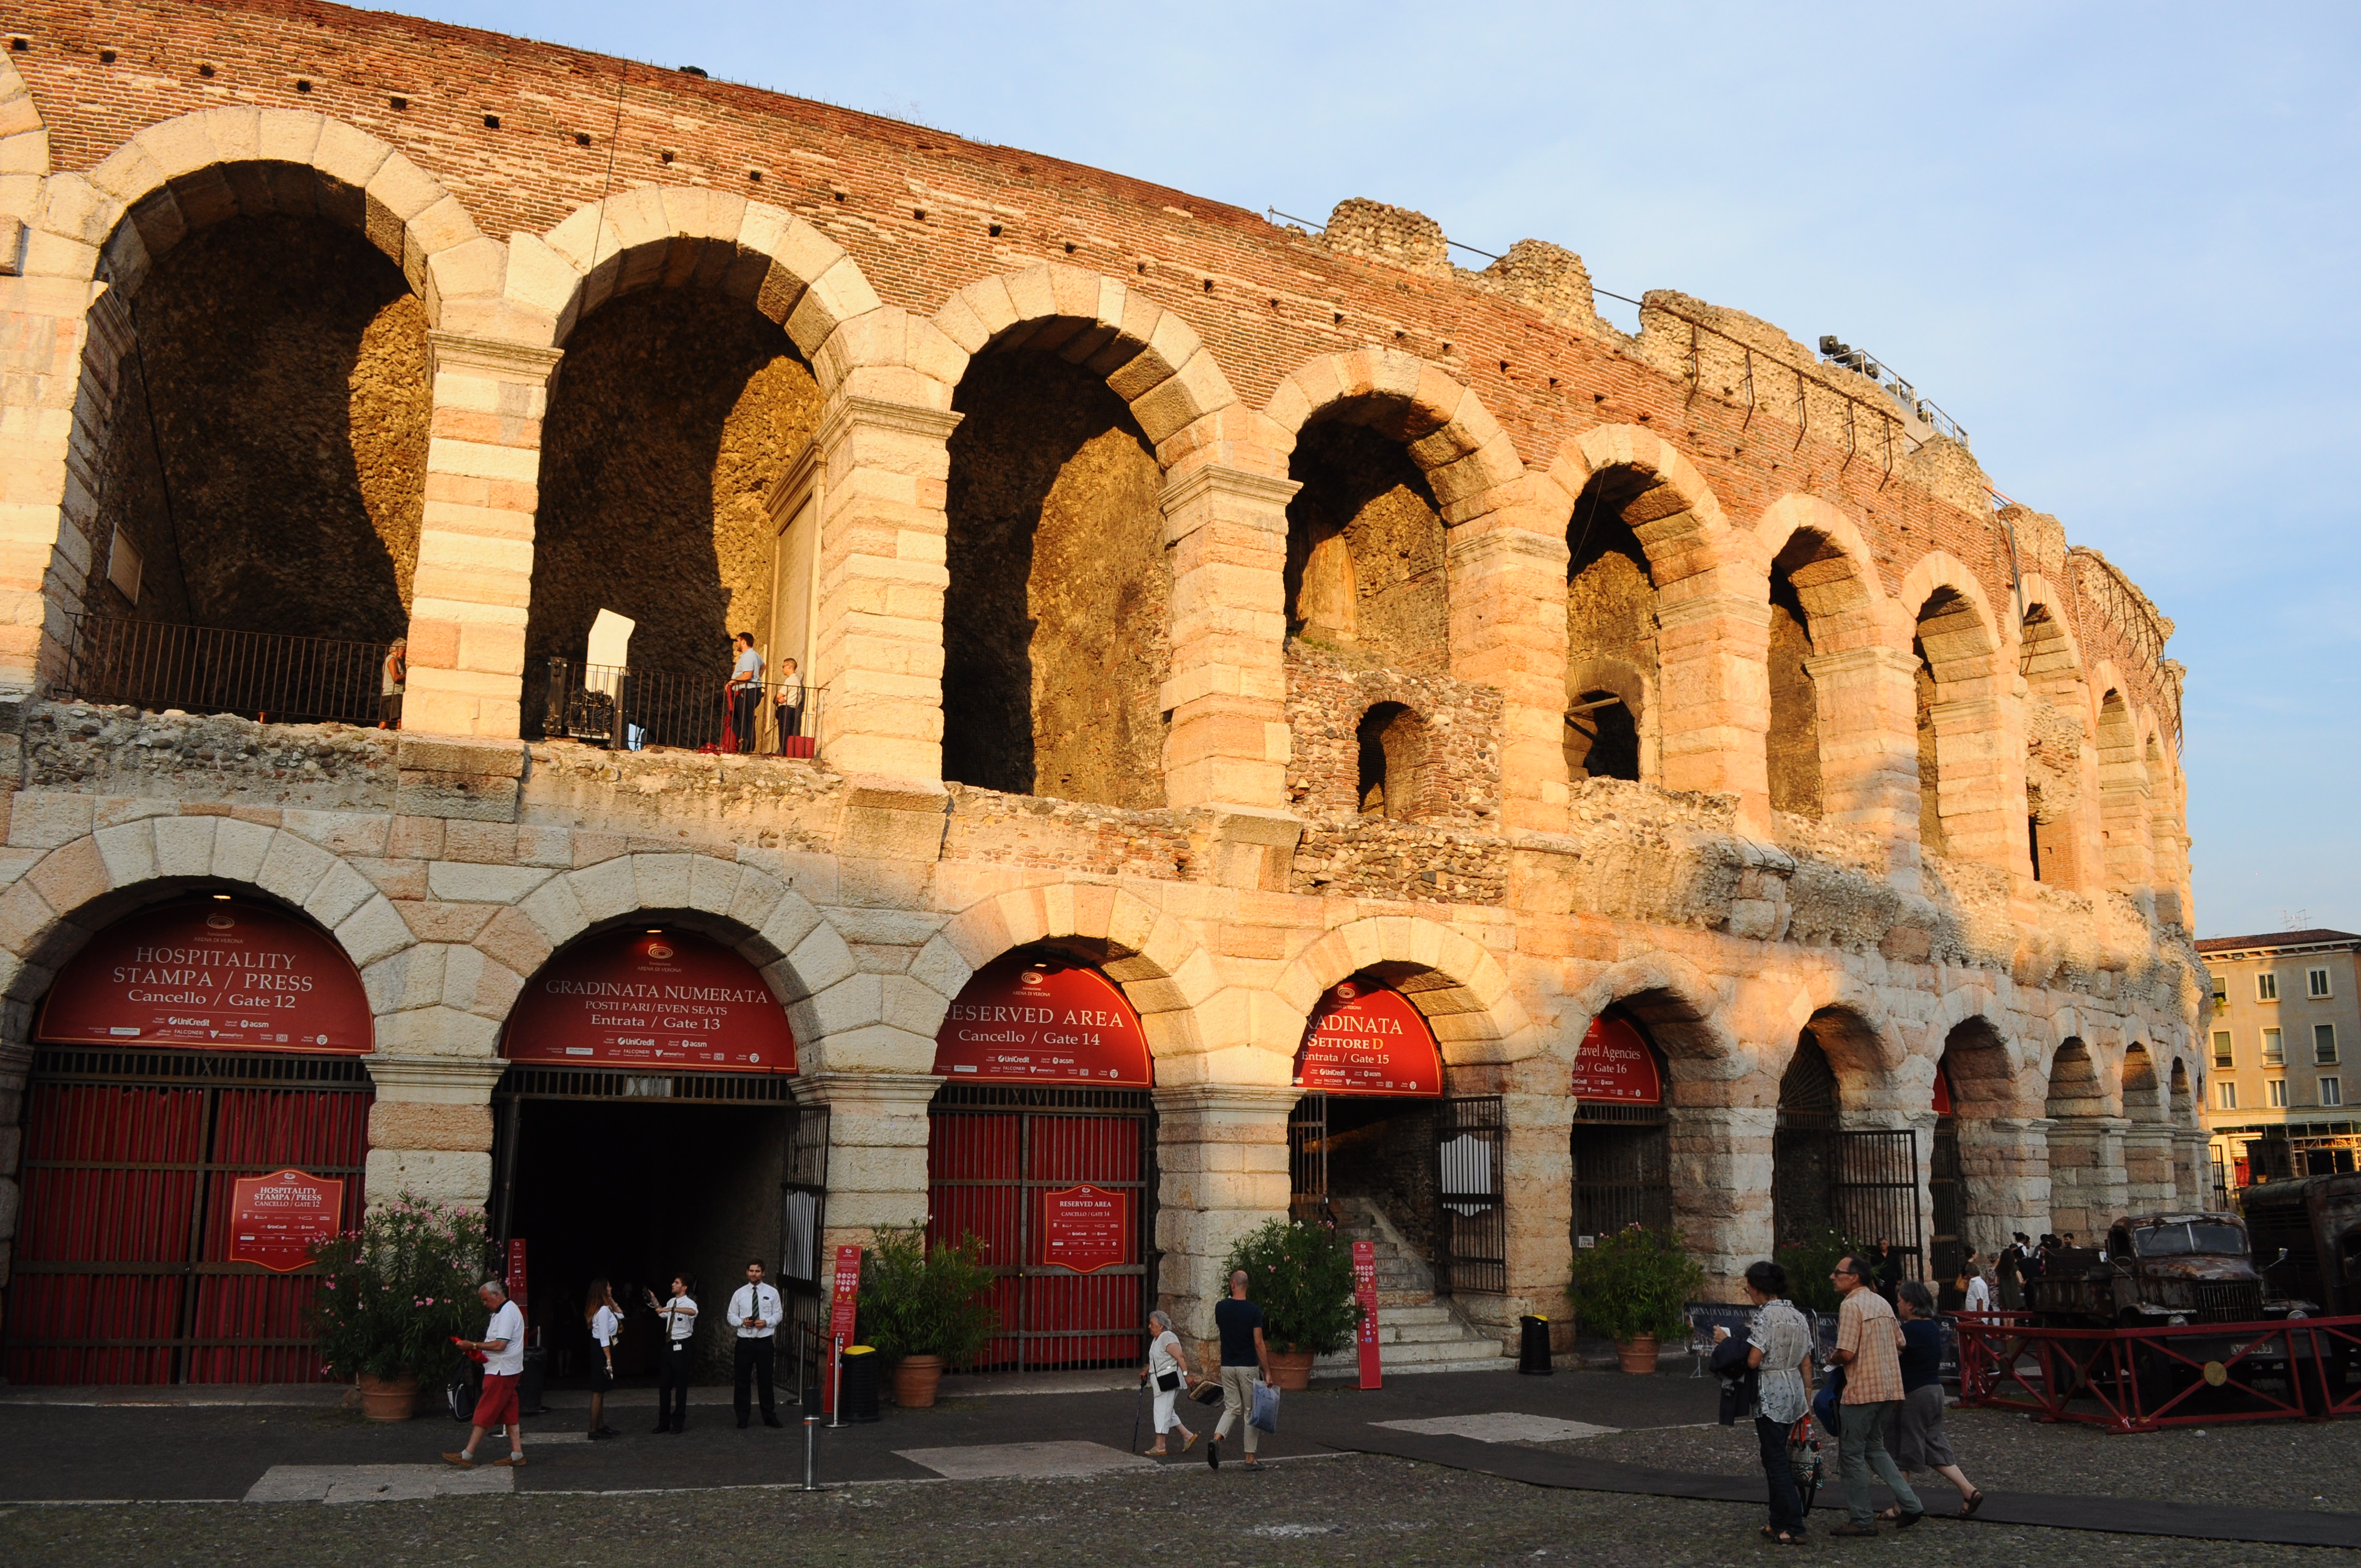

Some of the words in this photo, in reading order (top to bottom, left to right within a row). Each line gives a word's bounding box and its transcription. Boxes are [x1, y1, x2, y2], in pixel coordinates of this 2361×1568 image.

[135, 947, 297, 970] HOSPITALITY
[113, 967, 214, 987] STAMPA
[224, 971, 233, 989] /
[243, 973, 313, 992] PRESS
[128, 989, 206, 1004] Cancello
[213, 992, 222, 1006] /
[229, 994, 270, 1006] Gate
[274, 994, 296, 1009] 12
[546, 980, 660, 998] GRADINATA
[664, 986, 769, 1004] NUMERATA
[585, 1000, 619, 1010] POSTI
[692, 1005, 727, 1015] SEATS
[177, 1017, 210, 1027] UniCredit
[591, 1014, 645, 1027] Entrata
[651, 1016, 658, 1028] /
[663, 1017, 698, 1029] Gate
[703, 1019, 721, 1030] 13
[1063, 1009, 1124, 1028] AREA
[959, 1029, 1025, 1043] Cancello
[1031, 1031, 1037, 1044] /
[1043, 1032, 1079, 1044] Gate
[1081, 1033, 1100, 1046] 14
[1372, 1038, 1384, 1050] D
[1302, 1051, 1339, 1062] Entrata
[1342, 1052, 1347, 1063] /
[1351, 1054, 1375, 1064] Gate
[1377, 1054, 1390, 1064] 15
[1602, 1044, 1641, 1062] Agencies
[1594, 1063, 1614, 1074] Gate
[1616, 1063, 1627, 1074] 16
[1689, 1306, 1709, 1316] ARENA
[1717, 1308, 1745, 1317] VERONA
